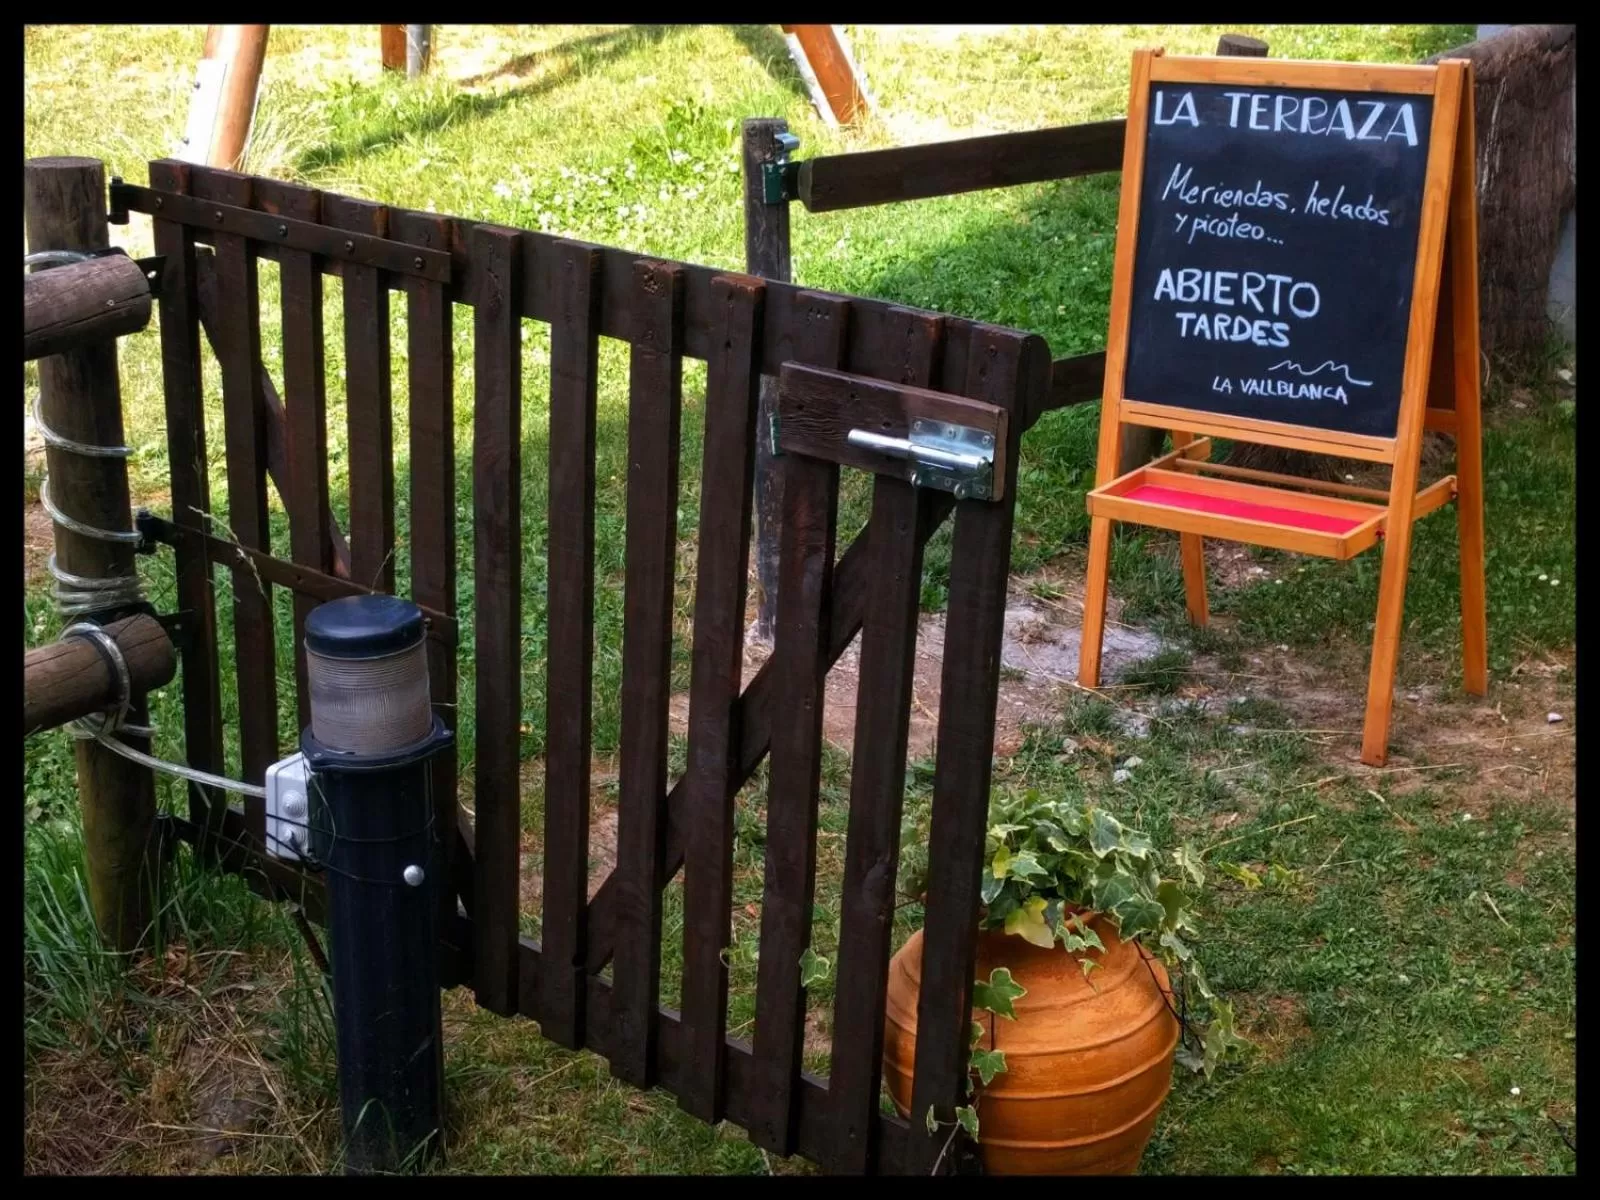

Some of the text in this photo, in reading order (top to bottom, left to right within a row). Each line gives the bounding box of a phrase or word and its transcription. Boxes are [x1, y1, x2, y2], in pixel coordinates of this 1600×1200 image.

[1154, 90, 1419, 147] LA TERRAZA
[1304, 180, 1391, 225] helados
[1153, 268, 1320, 318] ABIERTO
[1175, 312, 1290, 348] TARDES
[1211, 376, 1232, 395] LA
